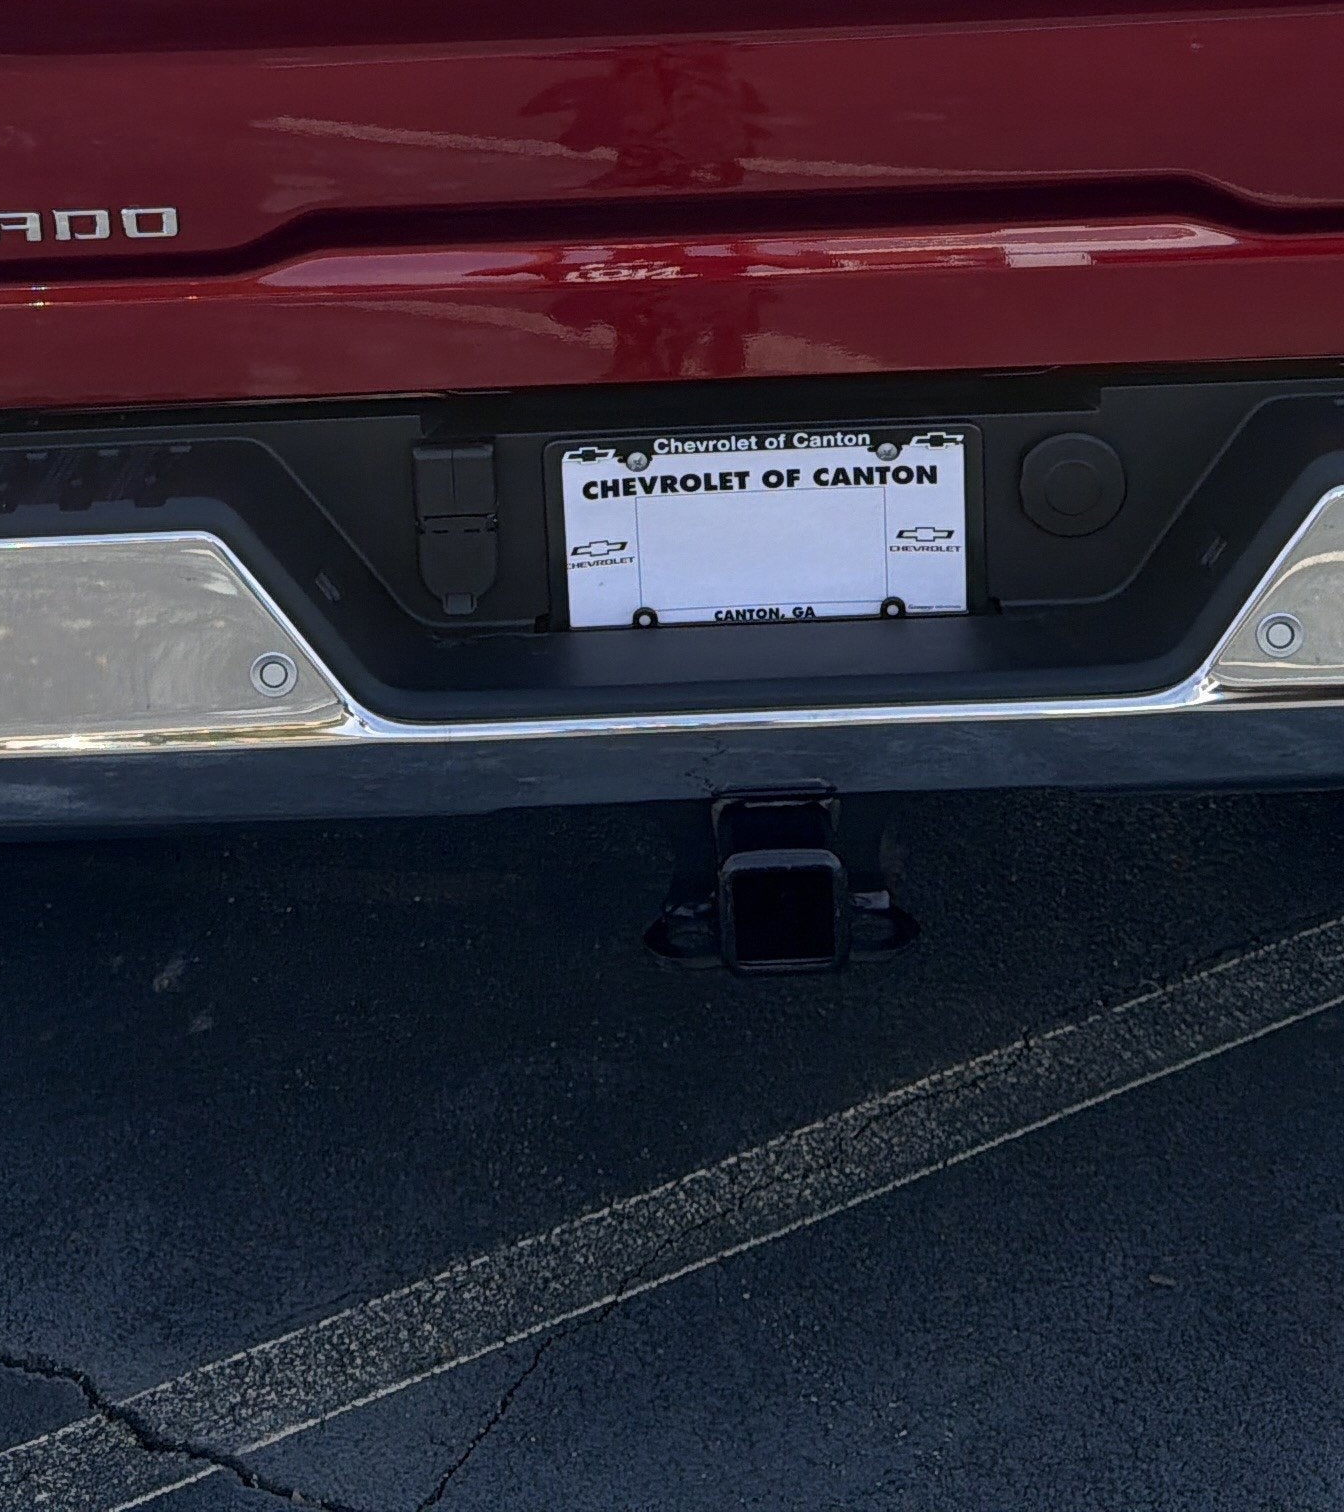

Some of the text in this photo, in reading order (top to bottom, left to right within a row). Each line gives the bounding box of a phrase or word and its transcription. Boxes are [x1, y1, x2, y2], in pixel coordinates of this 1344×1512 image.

[653, 431, 872, 455] Chevrolet of Canton
[582, 464, 938, 501] CHEVROLET OF CANTON
[889, 544, 962, 553] CHEVROLET
[791, 605, 816, 619] GA
